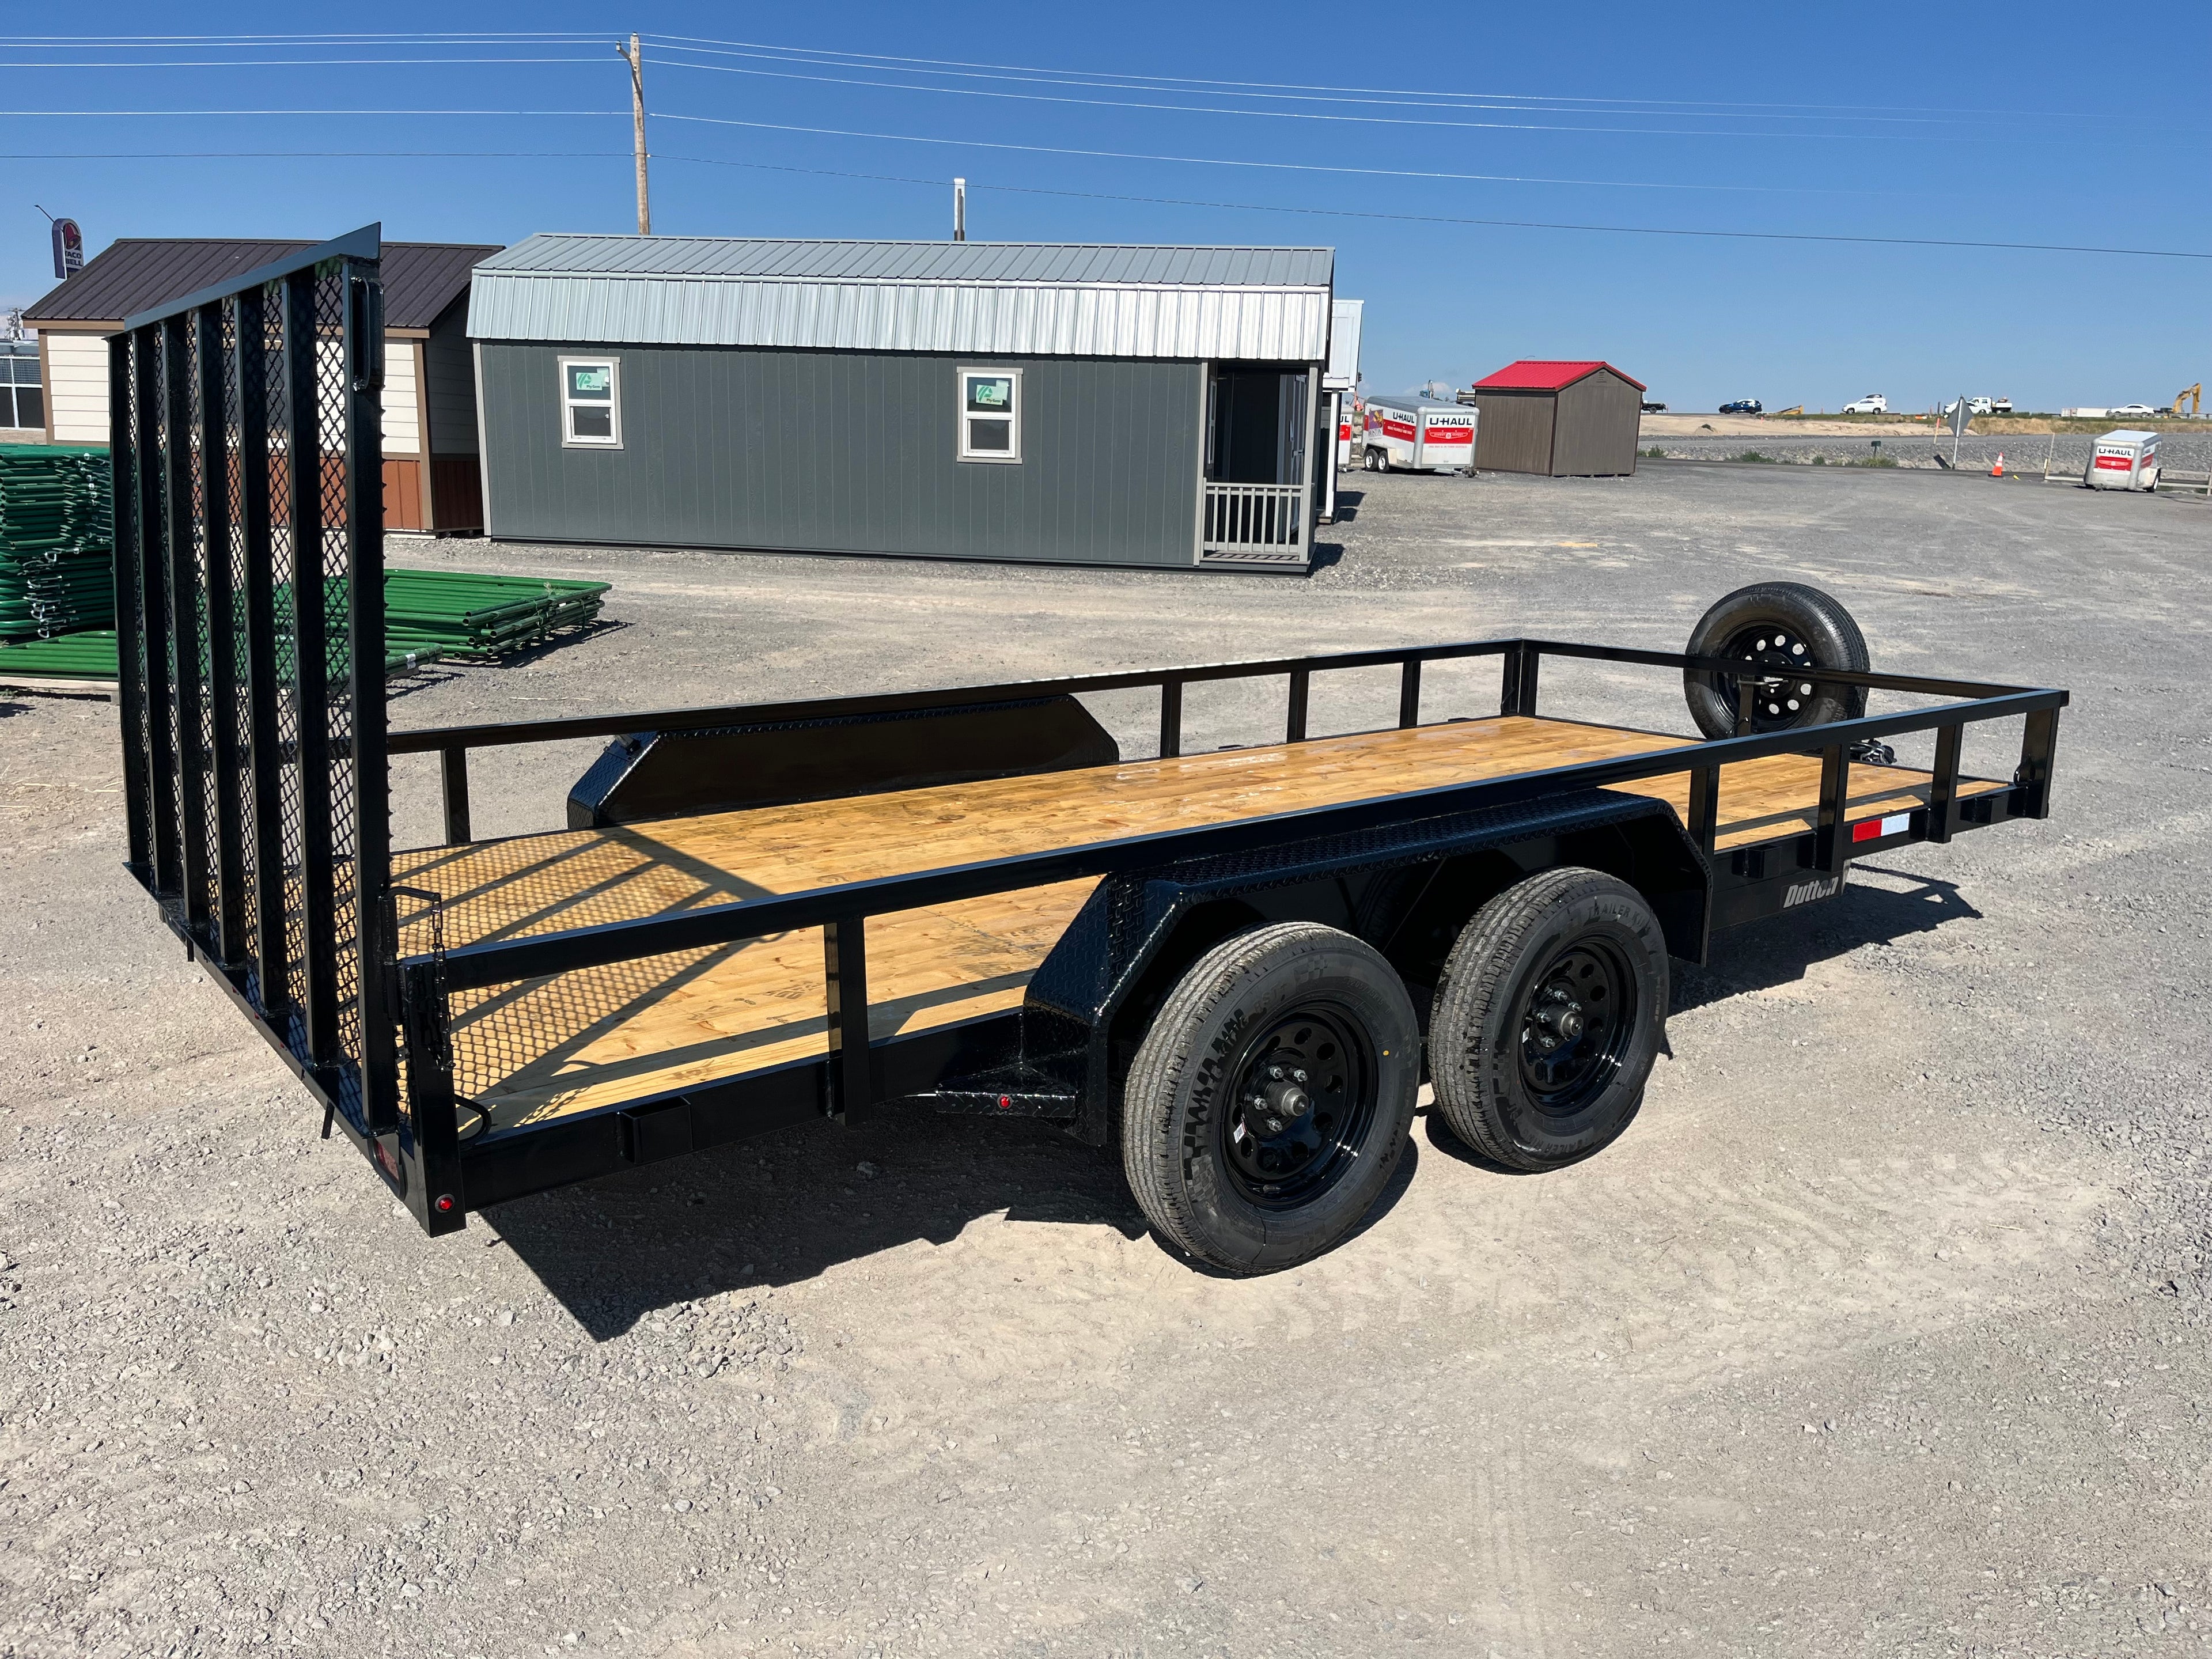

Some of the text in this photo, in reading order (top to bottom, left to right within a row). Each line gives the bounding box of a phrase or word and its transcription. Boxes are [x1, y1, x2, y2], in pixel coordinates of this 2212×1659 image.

[65, 251, 82, 259] TACO
[65, 258, 82, 266] BELL
[1393, 411, 1415, 423] U-HAUL
[1429, 418, 1472, 426] U-HAUL
[1783, 876, 1839, 908] Dutton
